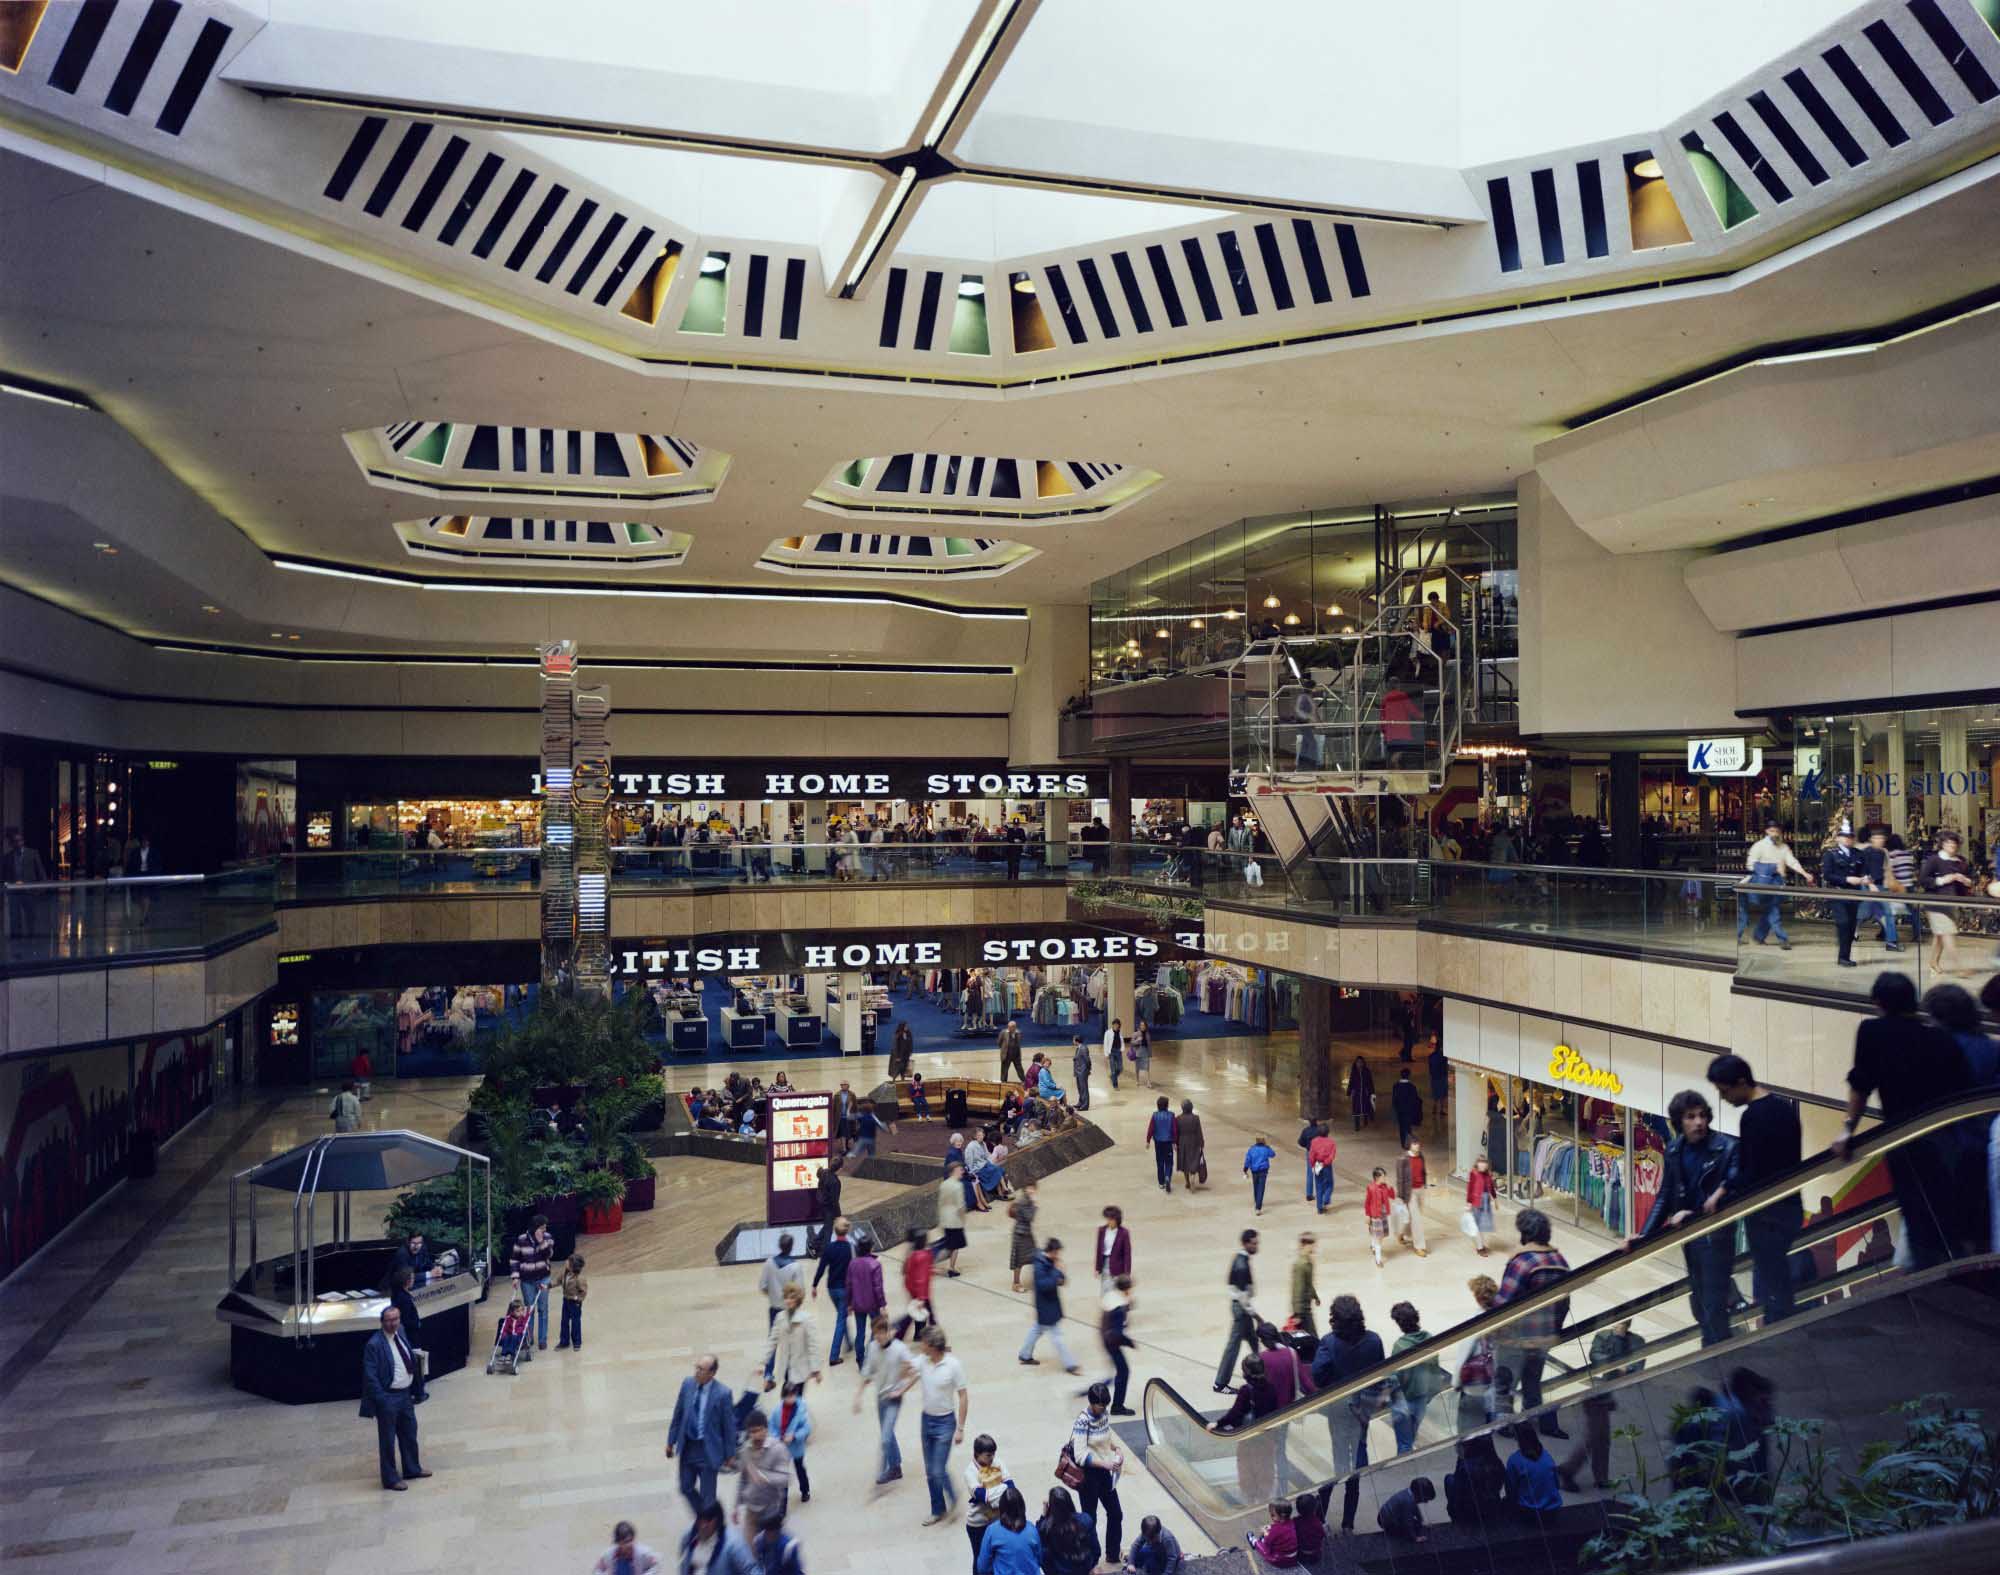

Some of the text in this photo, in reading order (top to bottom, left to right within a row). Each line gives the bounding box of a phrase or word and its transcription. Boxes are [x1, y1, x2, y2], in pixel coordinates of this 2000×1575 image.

[1692, 742, 1737, 770] K SHOE
[1714, 757, 1739, 766] SHOP
[766, 774, 890, 794] HOME
[928, 774, 1088, 794] STORES
[1801, 769, 1989, 801] K SHOE SHOP
[805, 943, 942, 968] HOME
[983, 937, 1159, 961] STORES
[1548, 1045, 1623, 1095] Etam
